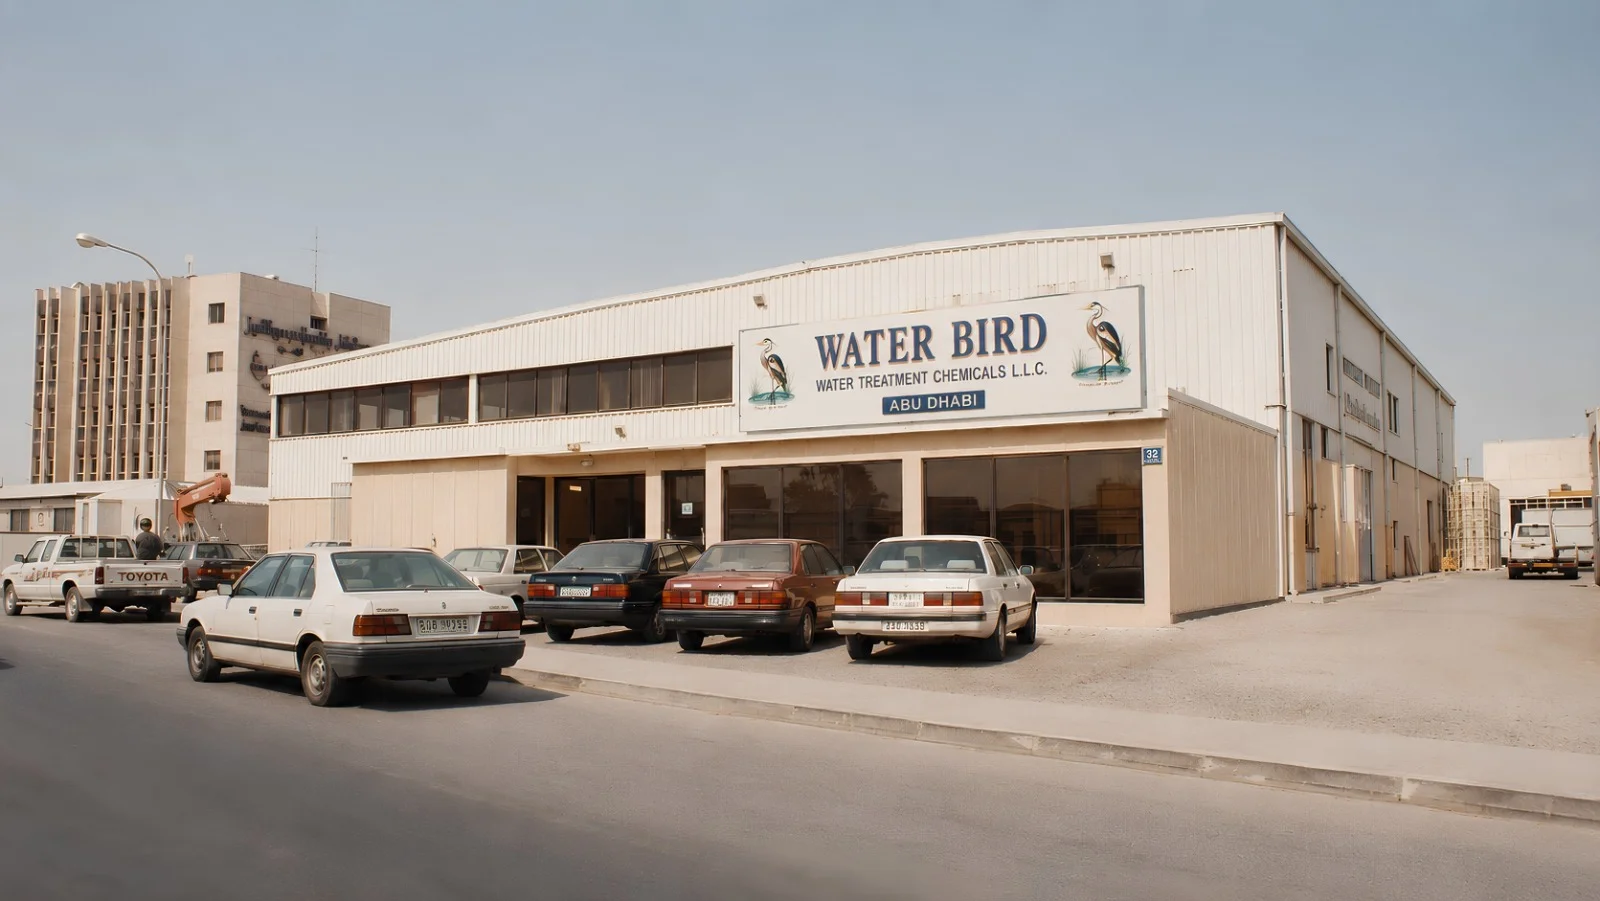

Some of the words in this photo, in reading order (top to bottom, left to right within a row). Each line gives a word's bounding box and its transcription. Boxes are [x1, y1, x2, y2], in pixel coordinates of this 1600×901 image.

[814, 325, 936, 371] WATER
[951, 313, 1047, 359] BIRD
[815, 377, 854, 392] WATER
[858, 371, 928, 389] TREATMENT
[933, 364, 1007, 383] CHEMICALS
[1012, 361, 1048, 377] L.L.C.
[889, 398, 921, 412] ABU
[927, 394, 977, 409] DHABI
[1146, 449, 1159, 459] 32
[117, 571, 169, 582] TOYOTA
